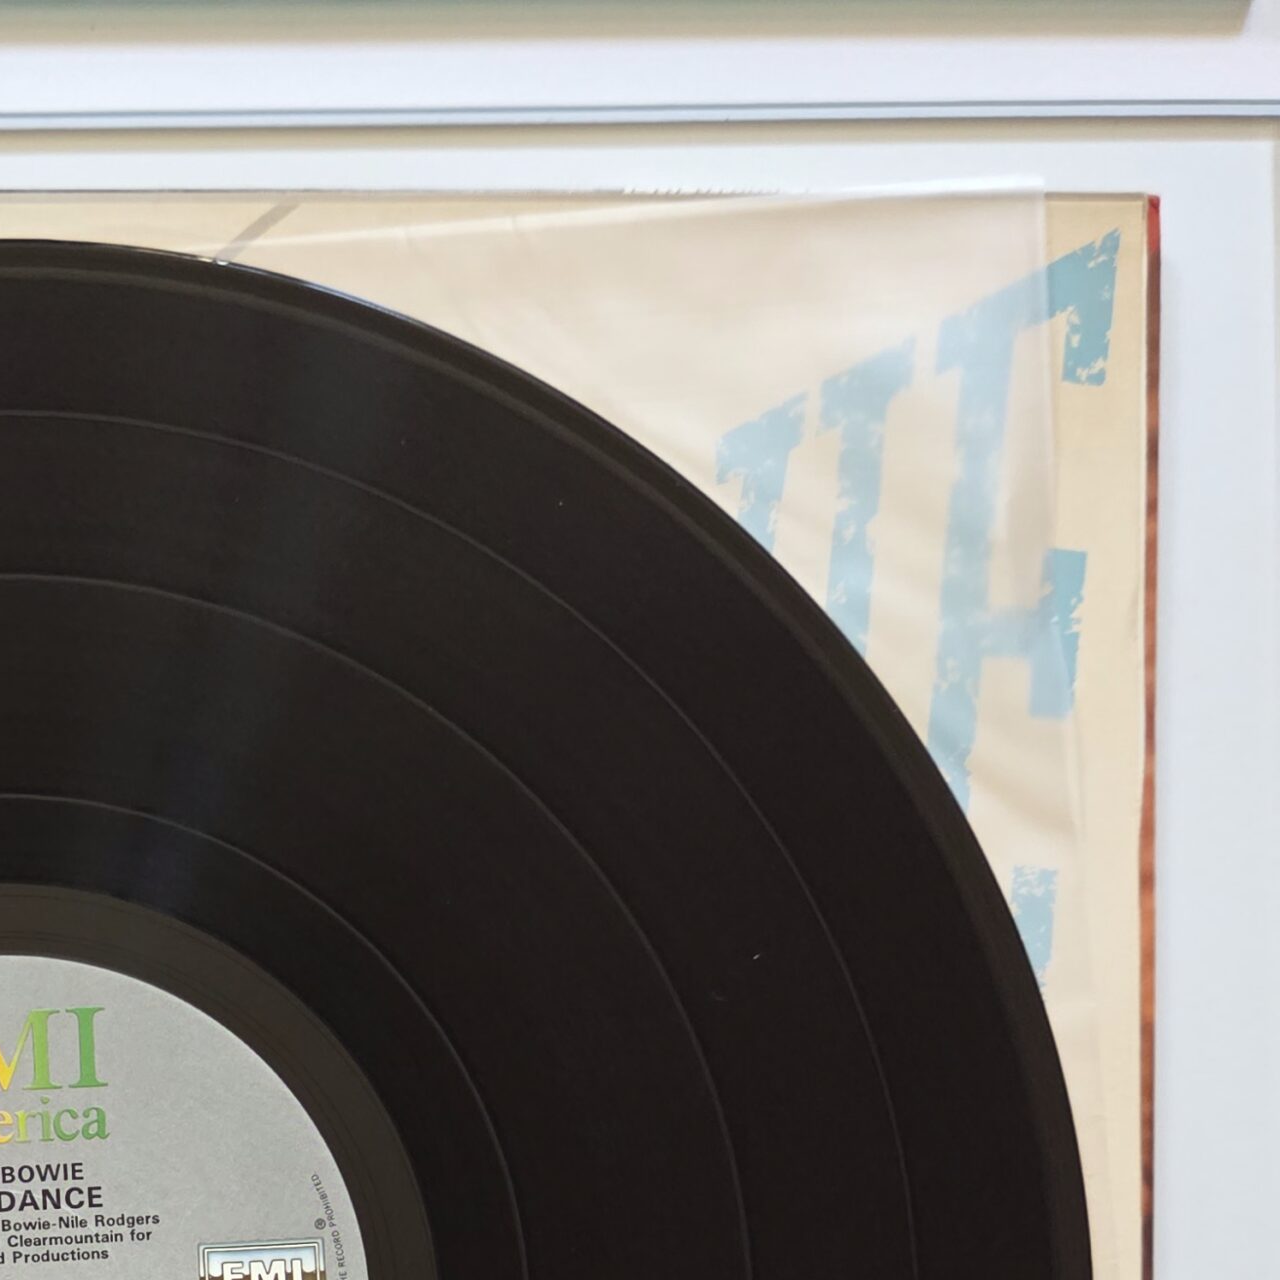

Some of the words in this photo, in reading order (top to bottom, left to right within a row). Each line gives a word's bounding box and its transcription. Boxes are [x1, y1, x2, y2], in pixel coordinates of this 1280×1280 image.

[1, 1162, 84, 1184] BOWIE
[1, 1216, 88, 1232] Bowie-Nile
[95, 1213, 160, 1228] Rodgers
[7, 1230, 123, 1247] Clearmountain
[130, 1229, 152, 1241] for
[13, 1248, 109, 1263] Productions
